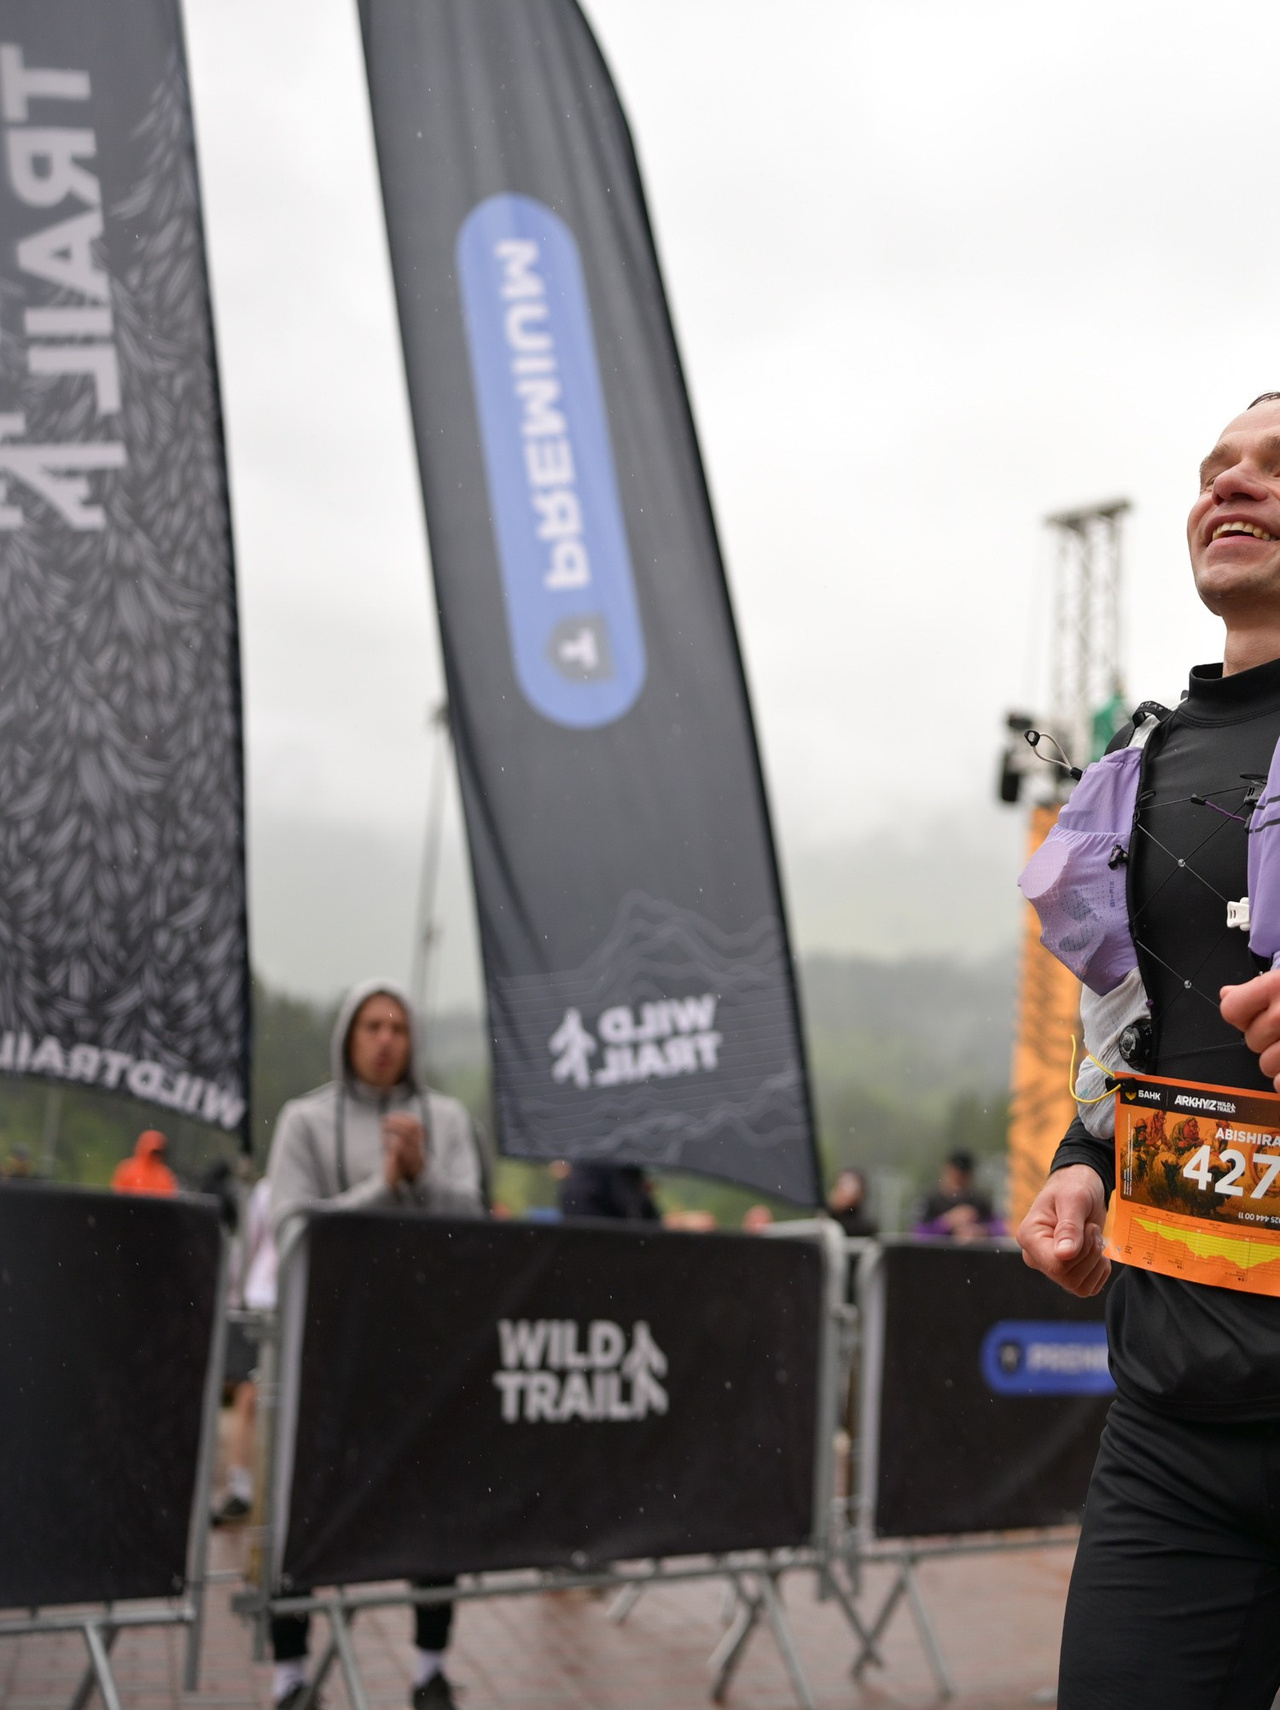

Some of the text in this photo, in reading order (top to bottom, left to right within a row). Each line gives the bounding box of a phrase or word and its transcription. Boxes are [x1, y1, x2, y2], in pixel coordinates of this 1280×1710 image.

[1138, 1089, 1161, 1101] БАНК
[1256, 1214, 1268, 1222] 444
[497, 1318, 626, 1369] WILD
[492, 1369, 633, 1424] TRAIL
